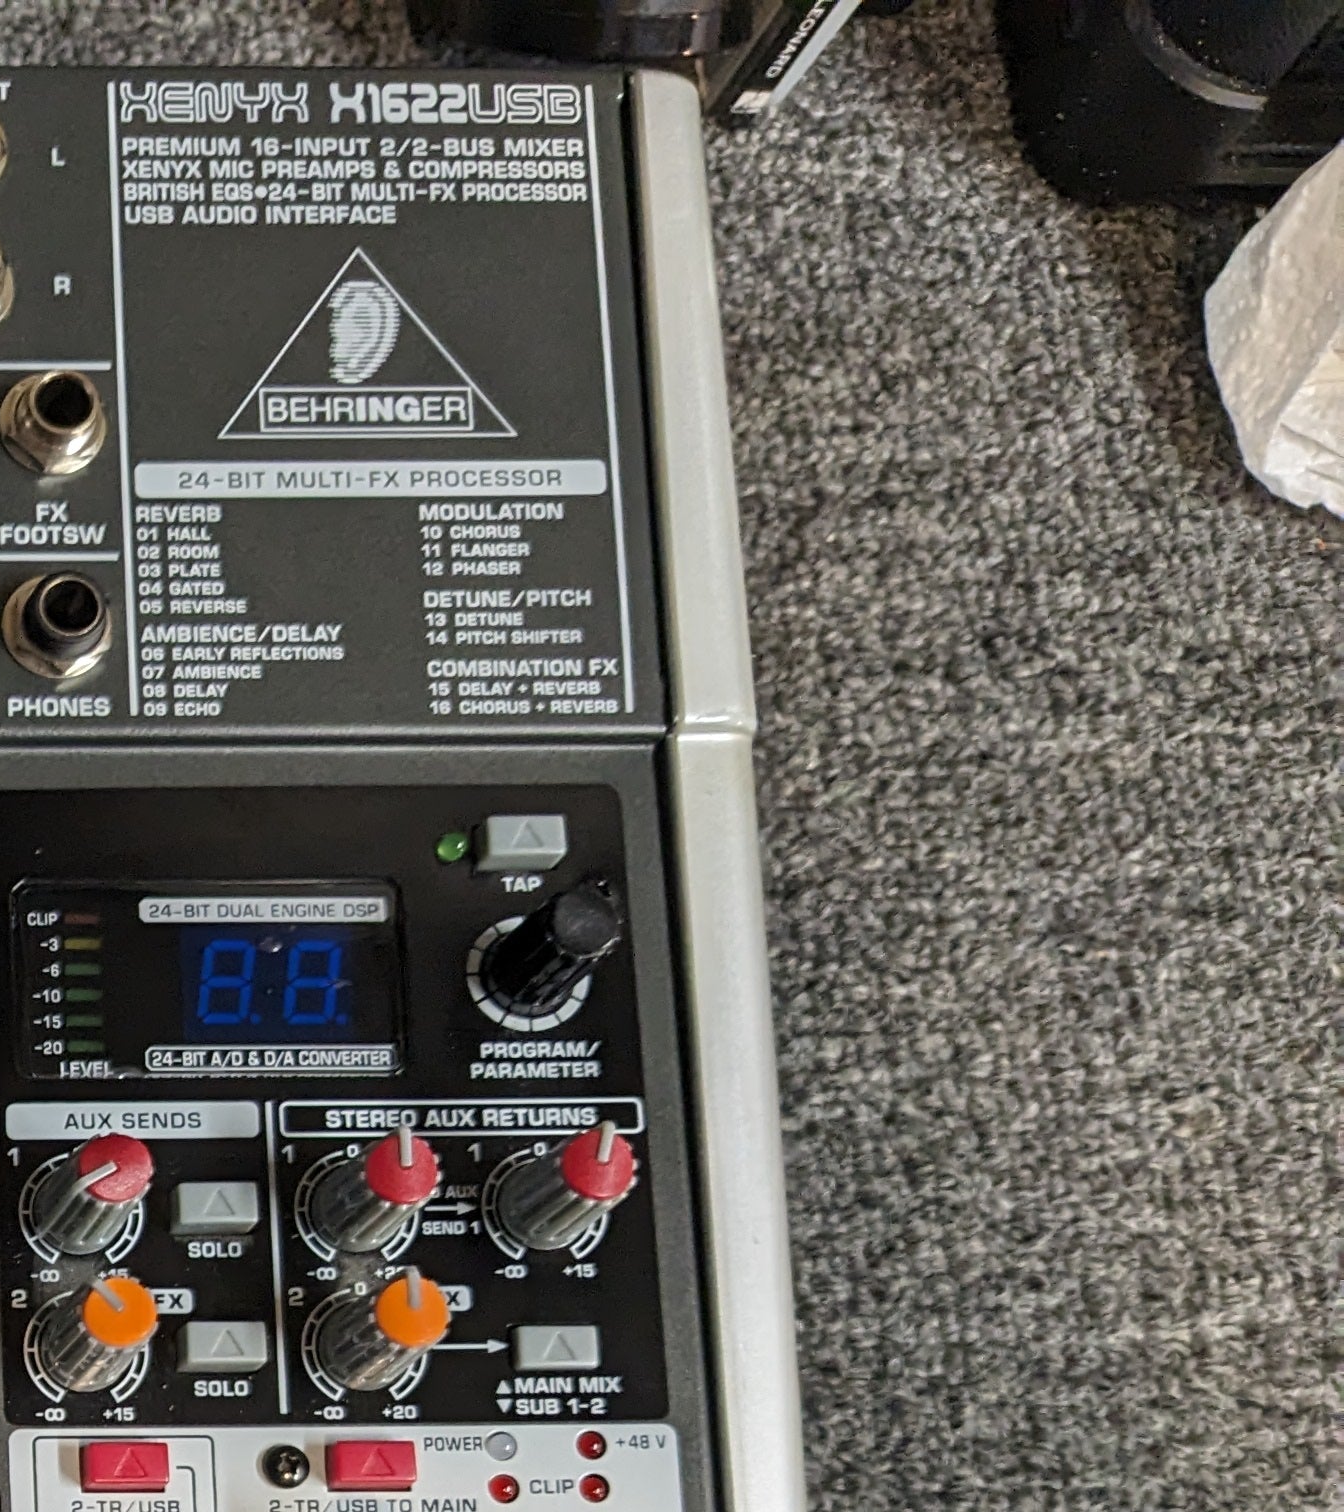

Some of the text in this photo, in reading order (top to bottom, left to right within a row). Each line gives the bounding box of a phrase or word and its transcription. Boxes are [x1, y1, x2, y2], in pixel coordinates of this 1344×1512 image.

[119, 81, 582, 125] XENYX X1622USB
[121, 136, 585, 157] PREMIUM 16-INPUT 2/2-BUS MIXER
[122, 159, 586, 180] XENYX MIC PREAMPS & COMPRESSORS
[123, 182, 205, 202] BRITISH
[350, 182, 457, 202] MULTI-FX
[462, 182, 588, 202] PROCESSOR
[124, 204, 397, 225] USB AUDIO INTERFACE
[267, 395, 467, 423] BEHRINGER
[178, 469, 562, 489] 24-BIT MULTI-FX PROCESSOR
[35, 502, 68, 523] FX
[135, 504, 222, 523] REVERB
[418, 502, 564, 521] MODULATION
[0, 524, 106, 545] FOOTSW
[136, 526, 211, 542] 01 HALL
[421, 542, 530, 558] 11 FLANGER
[139, 599, 247, 615] 05 REVERSE
[423, 589, 592, 608] DETUNE/PITCH
[140, 624, 342, 643] AMBIENCE/DELAY
[425, 629, 583, 645] 14 PITCH SHIFTER
[141, 645, 345, 662] 06 EARLY REFLECTIONS
[426, 657, 618, 678] COMBINATION FX
[7, 696, 111, 717] PHONES
[500, 875, 543, 893] TAP
[26, 911, 59, 927] CLIP
[149, 903, 379, 919] 24-BIT DUAL ENGINE DSP
[152, 1050, 391, 1067] 24-BIT A/D & D/A CONVERTER
[480, 1041, 599, 1059] PROGRAM/
[470, 1060, 599, 1079] PARAMETER
[64, 1111, 202, 1130] AUX SENDS
[324, 1107, 597, 1130] STEREO AUX RETURNS
[187, 1241, 242, 1259] SOLO
[514, 1376, 622, 1394] MAIN MIX
[515, 1397, 606, 1415] SUB 1-2
[423, 1436, 483, 1452] POWER
